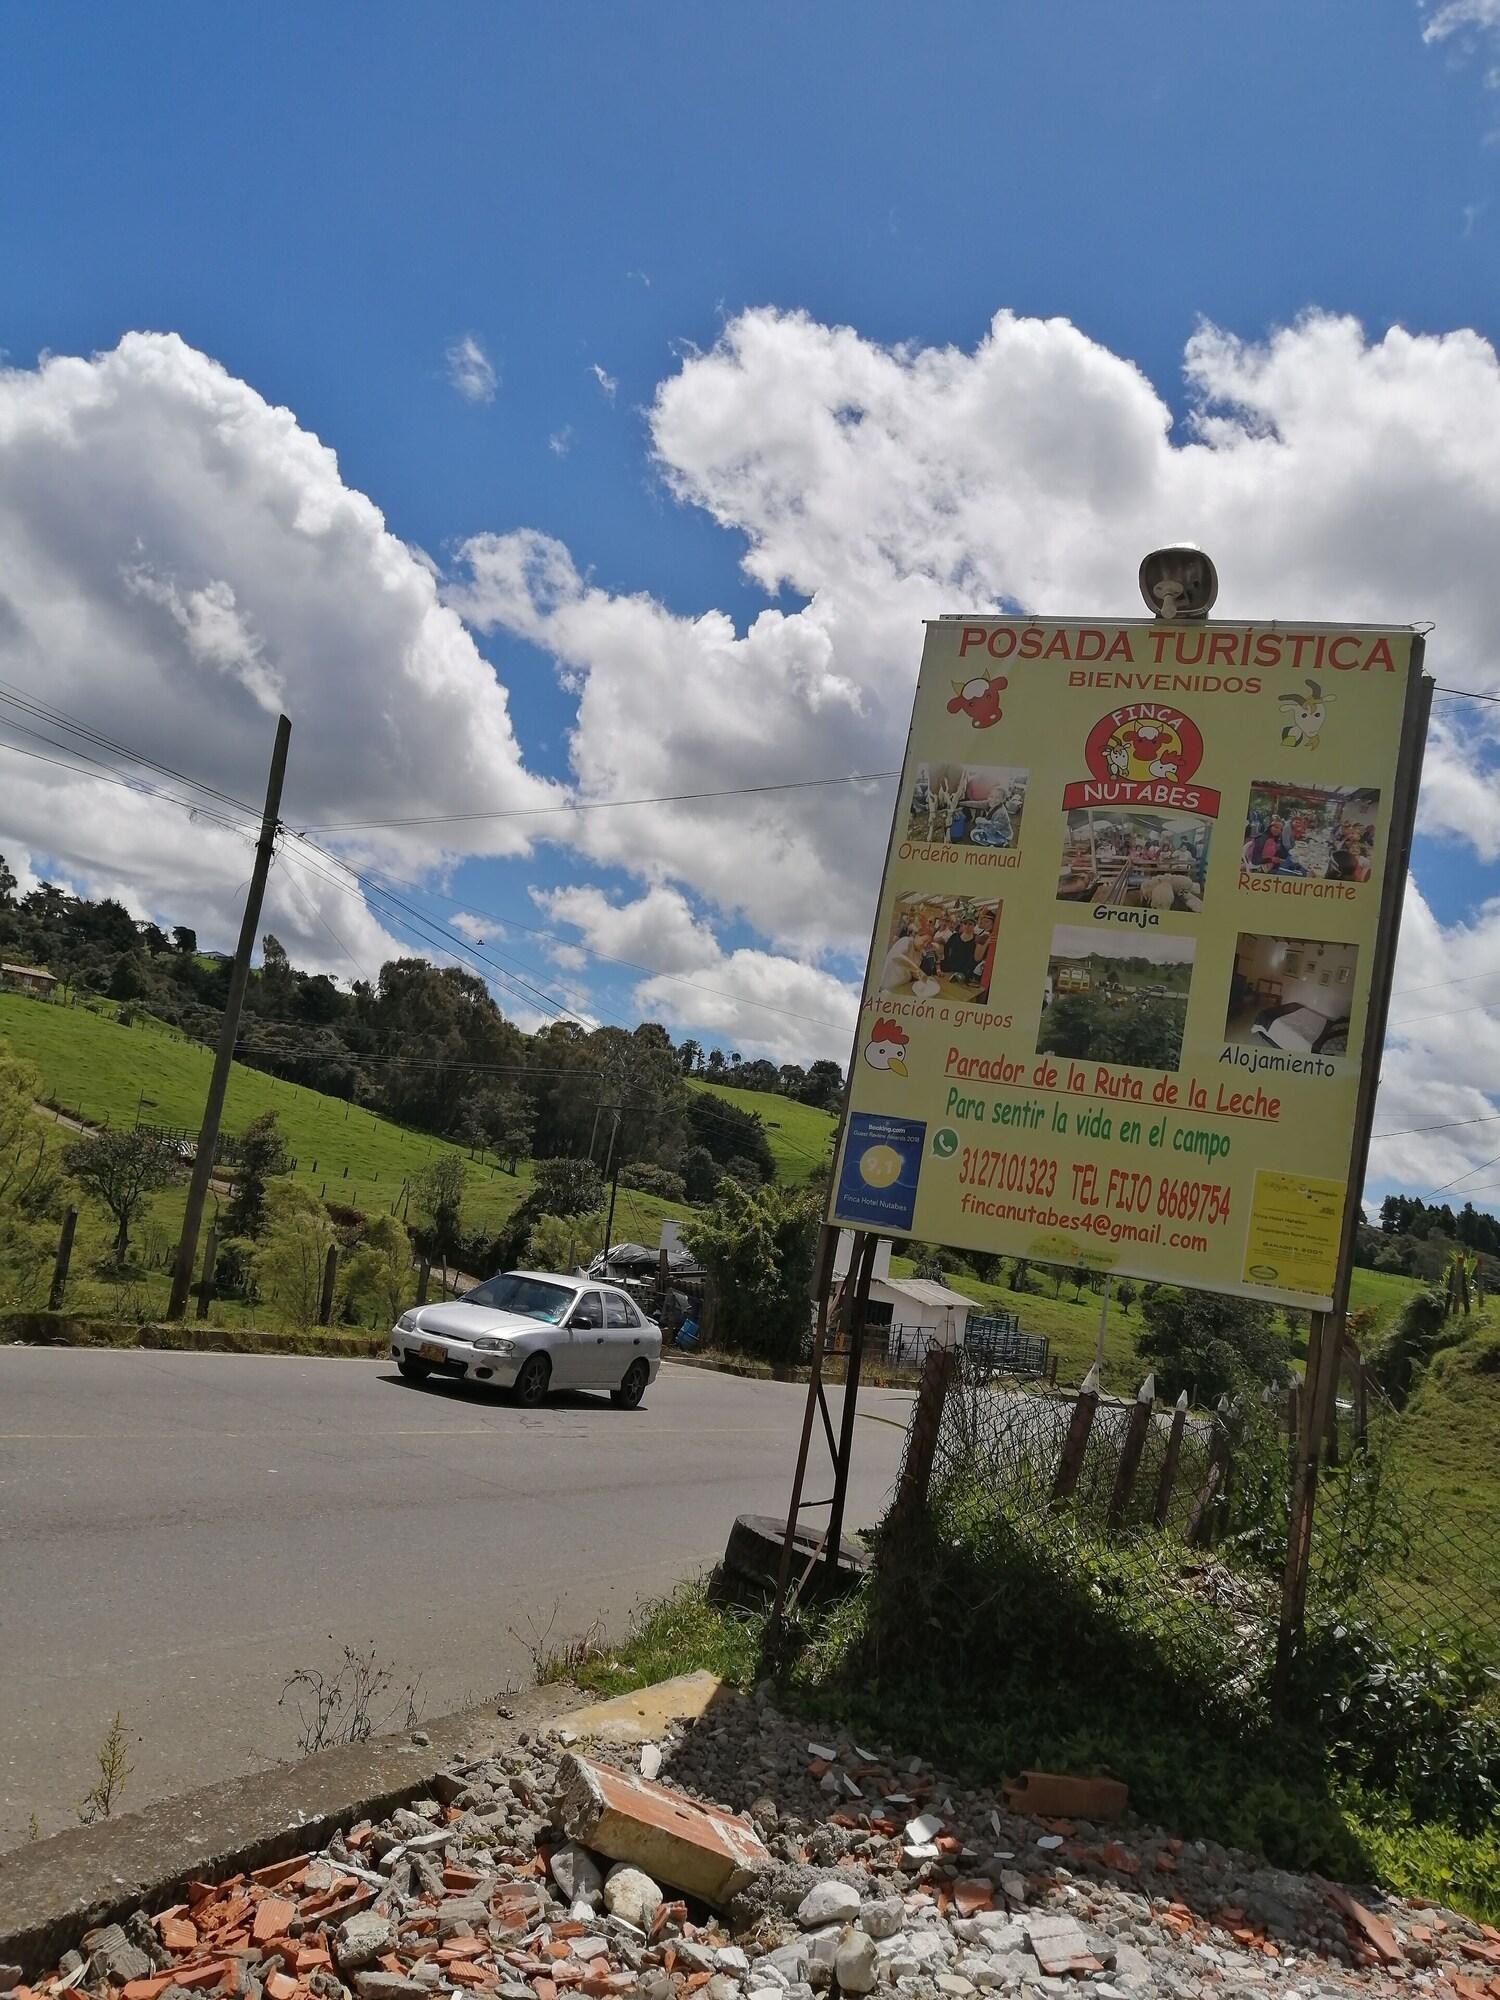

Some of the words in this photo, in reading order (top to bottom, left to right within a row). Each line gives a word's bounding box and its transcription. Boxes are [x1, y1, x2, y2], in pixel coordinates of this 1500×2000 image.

[958, 627, 1134, 663] POSADA
[1148, 627, 1396, 672] TURÍSTICA
[1068, 671, 1262, 694] BIENVENIDOS
[1112, 704, 1183, 731] FINCA
[1084, 783, 1200, 808] NUTABES
[898, 842, 959, 864] Ordeño
[965, 851, 1022, 868] manual
[1238, 872, 1357, 900] Restaurante
[1093, 904, 1159, 928] Granja
[862, 998, 934, 1019] Atención
[939, 1008, 950, 1021] a
[953, 1009, 1013, 1031] grupos
[1218, 1046, 1335, 1077] Alojamiento
[945, 1047, 1025, 1083] Parador
[1032, 1058, 1058, 1088] de
[1067, 1062, 1086, 1092] la
[1094, 1067, 1143, 1101] Ruta
[1152, 1074, 1179, 1105] de
[1188, 1078, 1207, 1110] la
[1216, 1082, 1281, 1119] Leche
[868, 1123, 906, 1134] Booking.com
[945, 1086, 985, 1122] Para
[991, 1098, 1045, 1130] sentir
[1051, 1100, 1067, 1134] la
[1076, 1107, 1112, 1141] vida
[1119, 1120, 1142, 1145] en
[1149, 1116, 1167, 1148] el
[1172, 1126, 1231, 1165] campo
[843, 1193, 860, 1204] Finca
[861, 1196, 879, 1206] Hotel
[959, 1147, 1057, 1198] 3127101323
[1072, 1163, 1100, 1206] TEL
[1106, 1168, 1153, 1213] FIJO
[1156, 1177, 1232, 1226] 8689754
